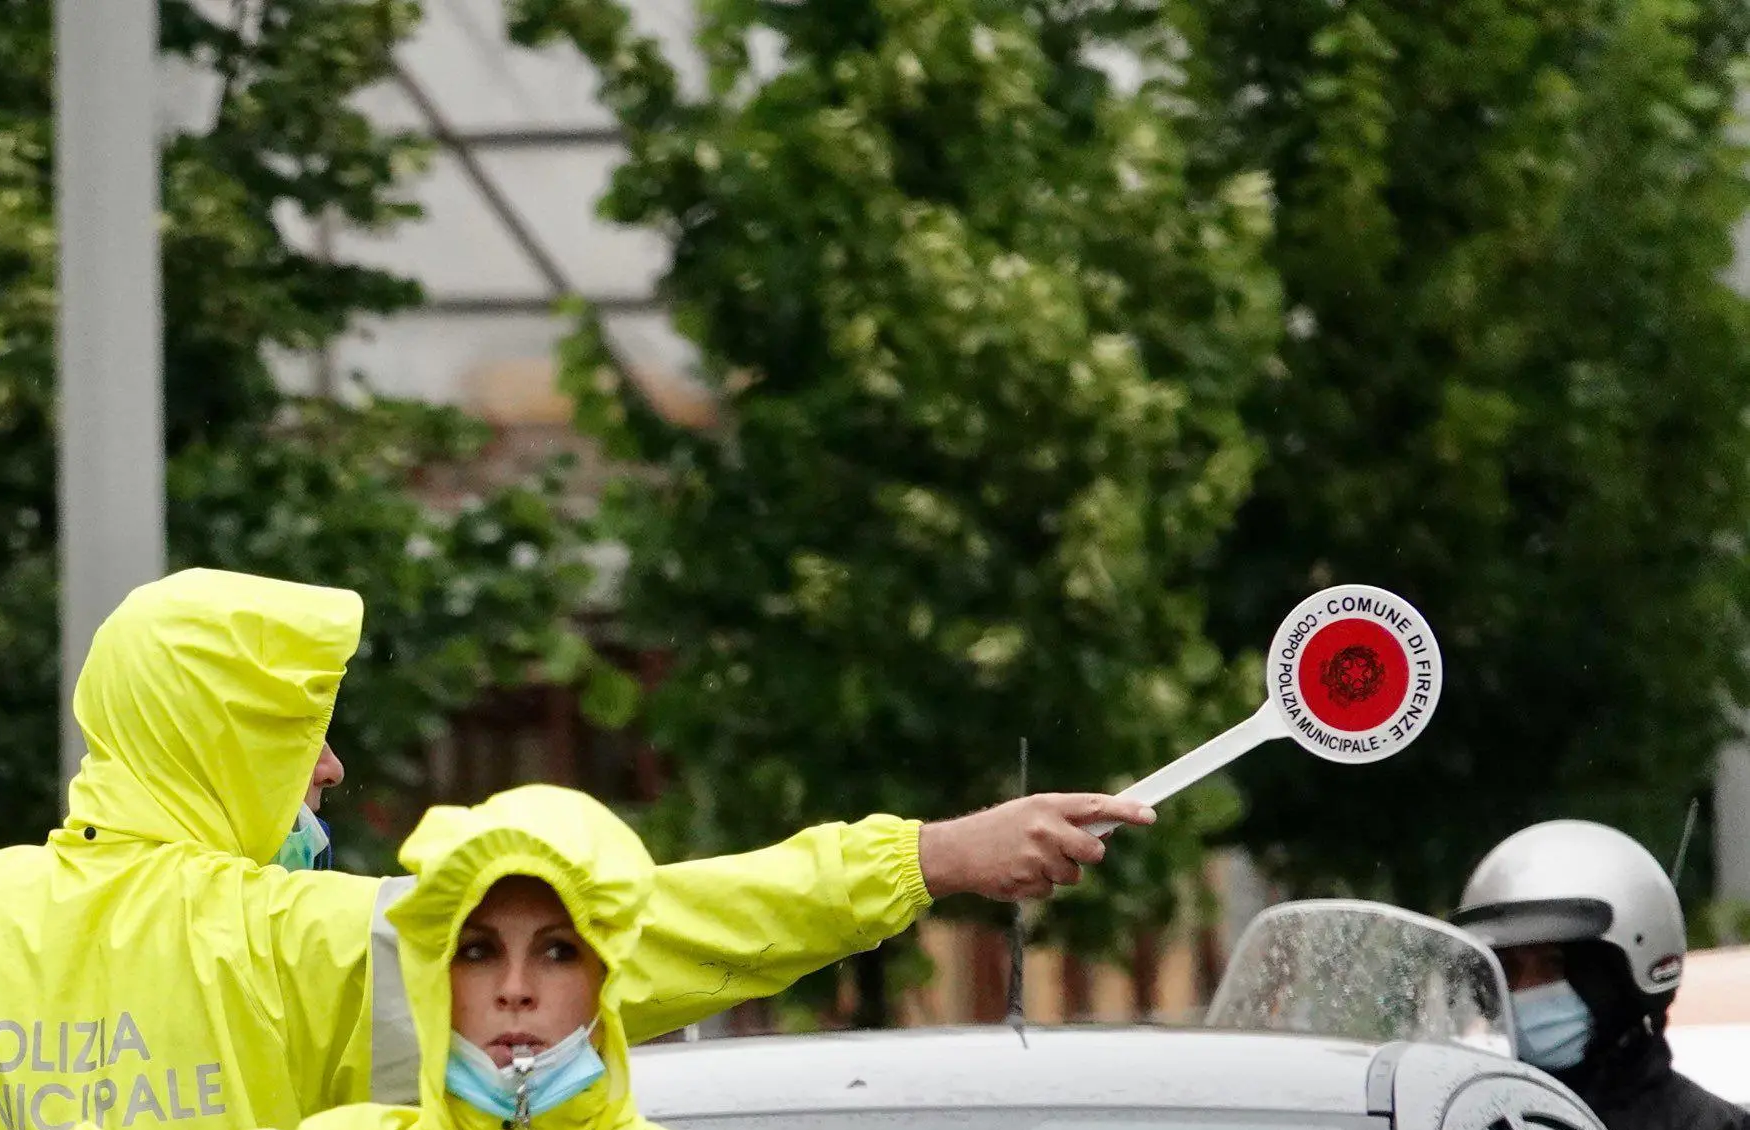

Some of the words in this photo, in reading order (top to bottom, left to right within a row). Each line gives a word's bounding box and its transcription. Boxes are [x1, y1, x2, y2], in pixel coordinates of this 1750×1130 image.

[1326, 596, 1412, 634] COMUNE
[1281, 613, 1319, 660] CORPO
[1407, 634, 1428, 656] DI
[1278, 662, 1303, 721] POLIZIA
[1388, 659, 1432, 742] FIRENZE
[1296, 716, 1381, 754] MUNICIPALE
